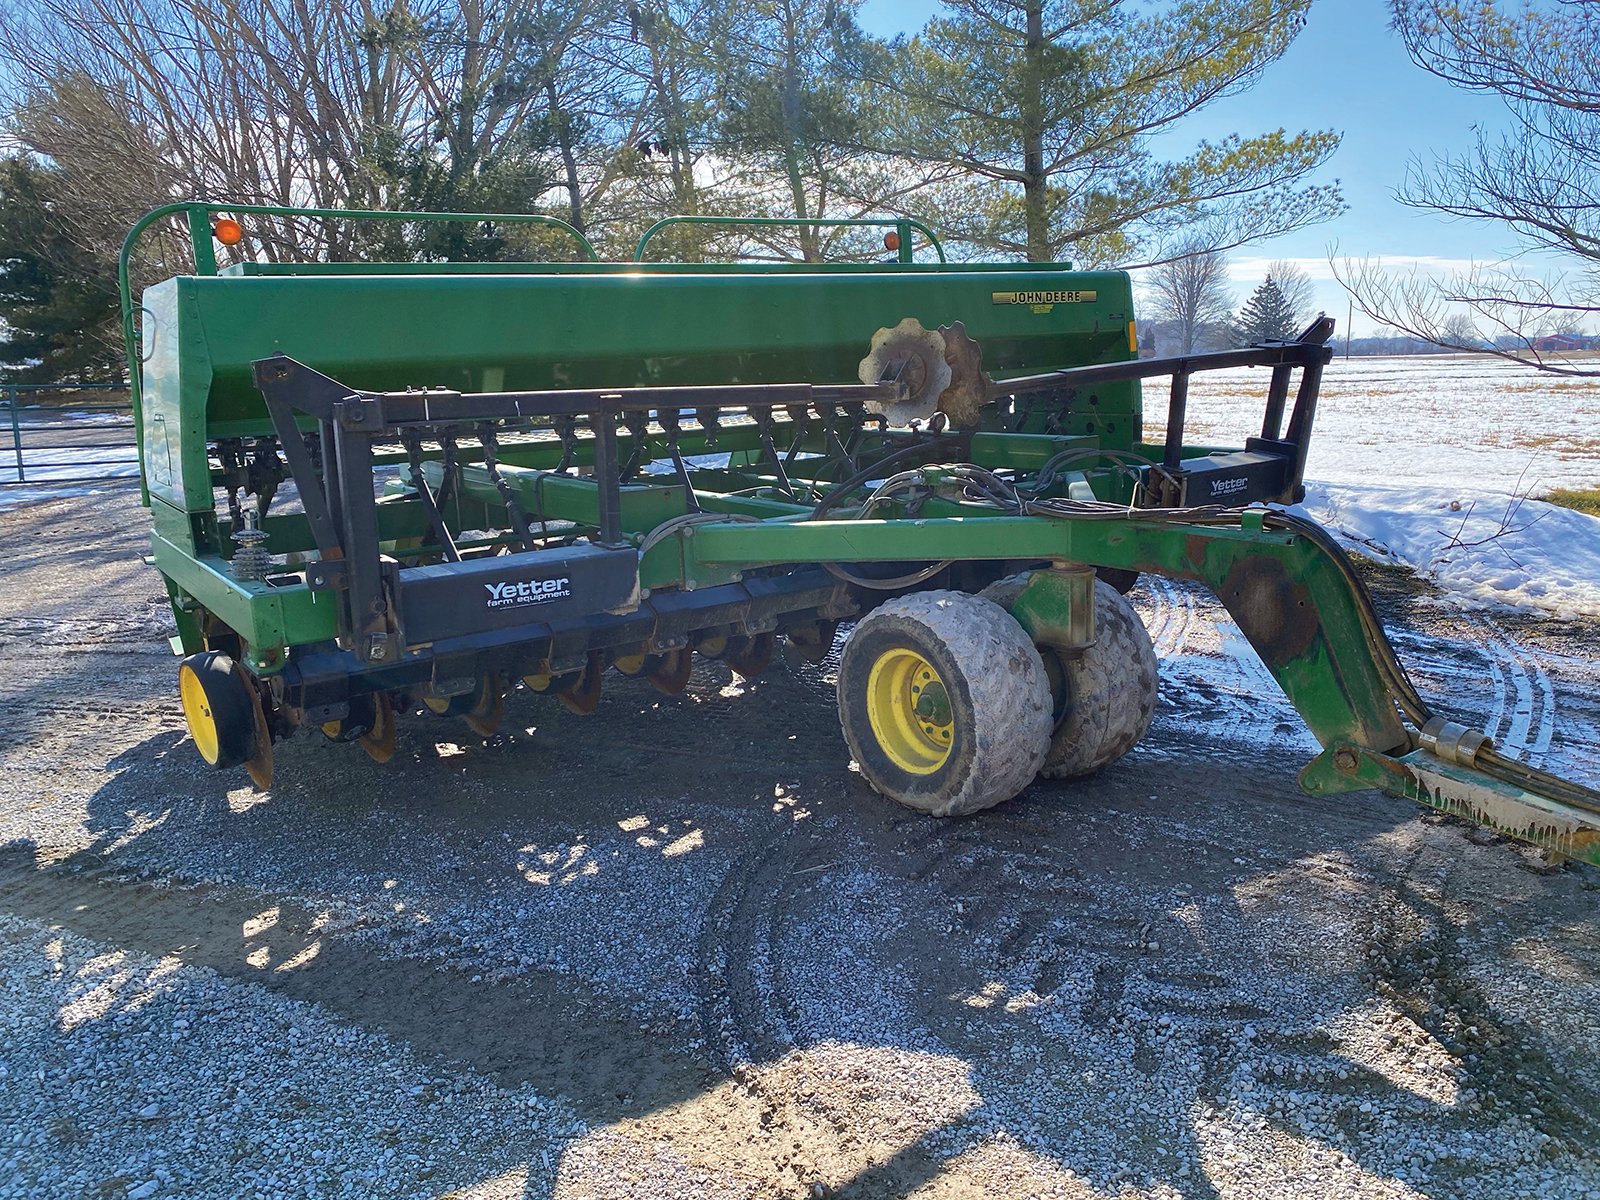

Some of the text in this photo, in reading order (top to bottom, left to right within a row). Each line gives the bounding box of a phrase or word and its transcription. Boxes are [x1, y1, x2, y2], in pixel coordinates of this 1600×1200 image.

[1011, 292, 1080, 303] JOHN DEERE
[1211, 478, 1248, 491] Yetter
[484, 578, 569, 599] Yetter
[487, 599, 513, 607] farm
[517, 590, 571, 603] equipment
